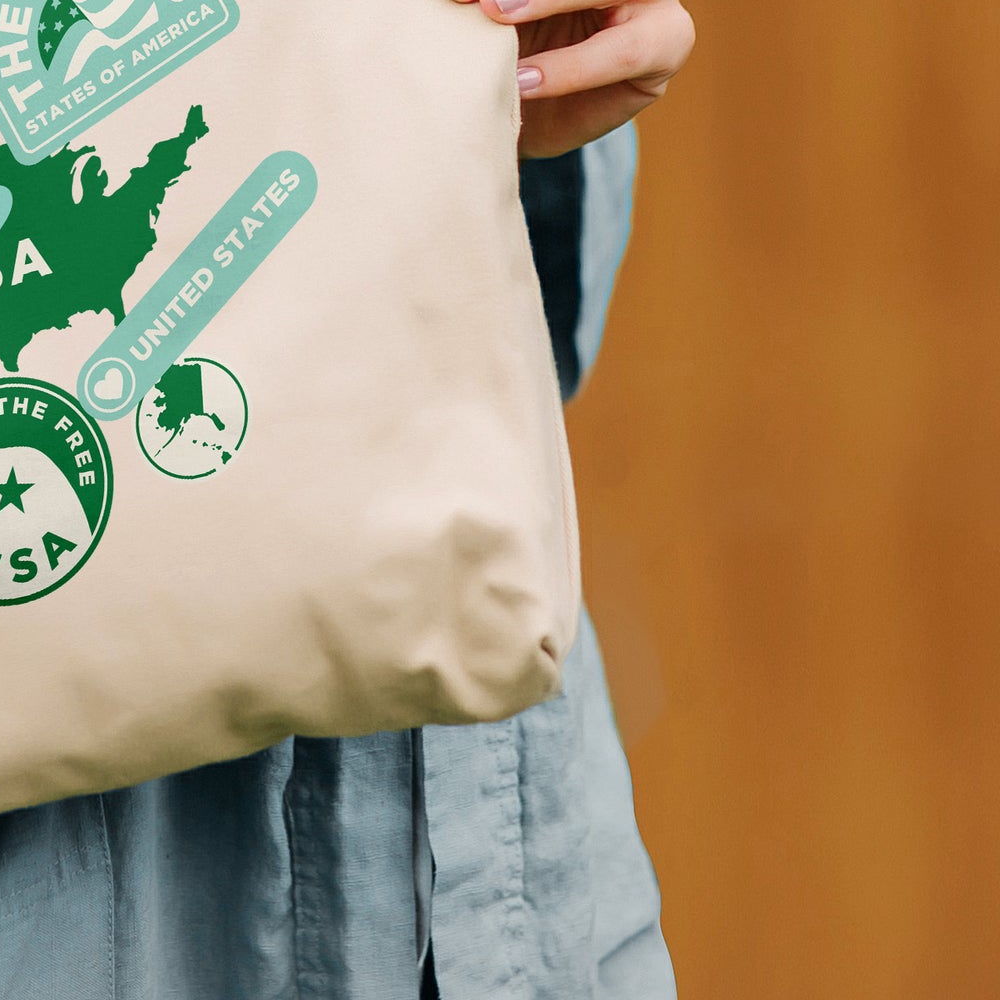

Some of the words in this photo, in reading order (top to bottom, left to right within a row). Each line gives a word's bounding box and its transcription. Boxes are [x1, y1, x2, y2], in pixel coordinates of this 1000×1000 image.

[25, 80, 97, 135] STATES
[99, 60, 126, 85] OF
[130, 3, 215, 66] AMERICA
[129, 267, 214, 362] UNITED
[212, 168, 301, 268] STATES
[54, 415, 96, 487] FREE
